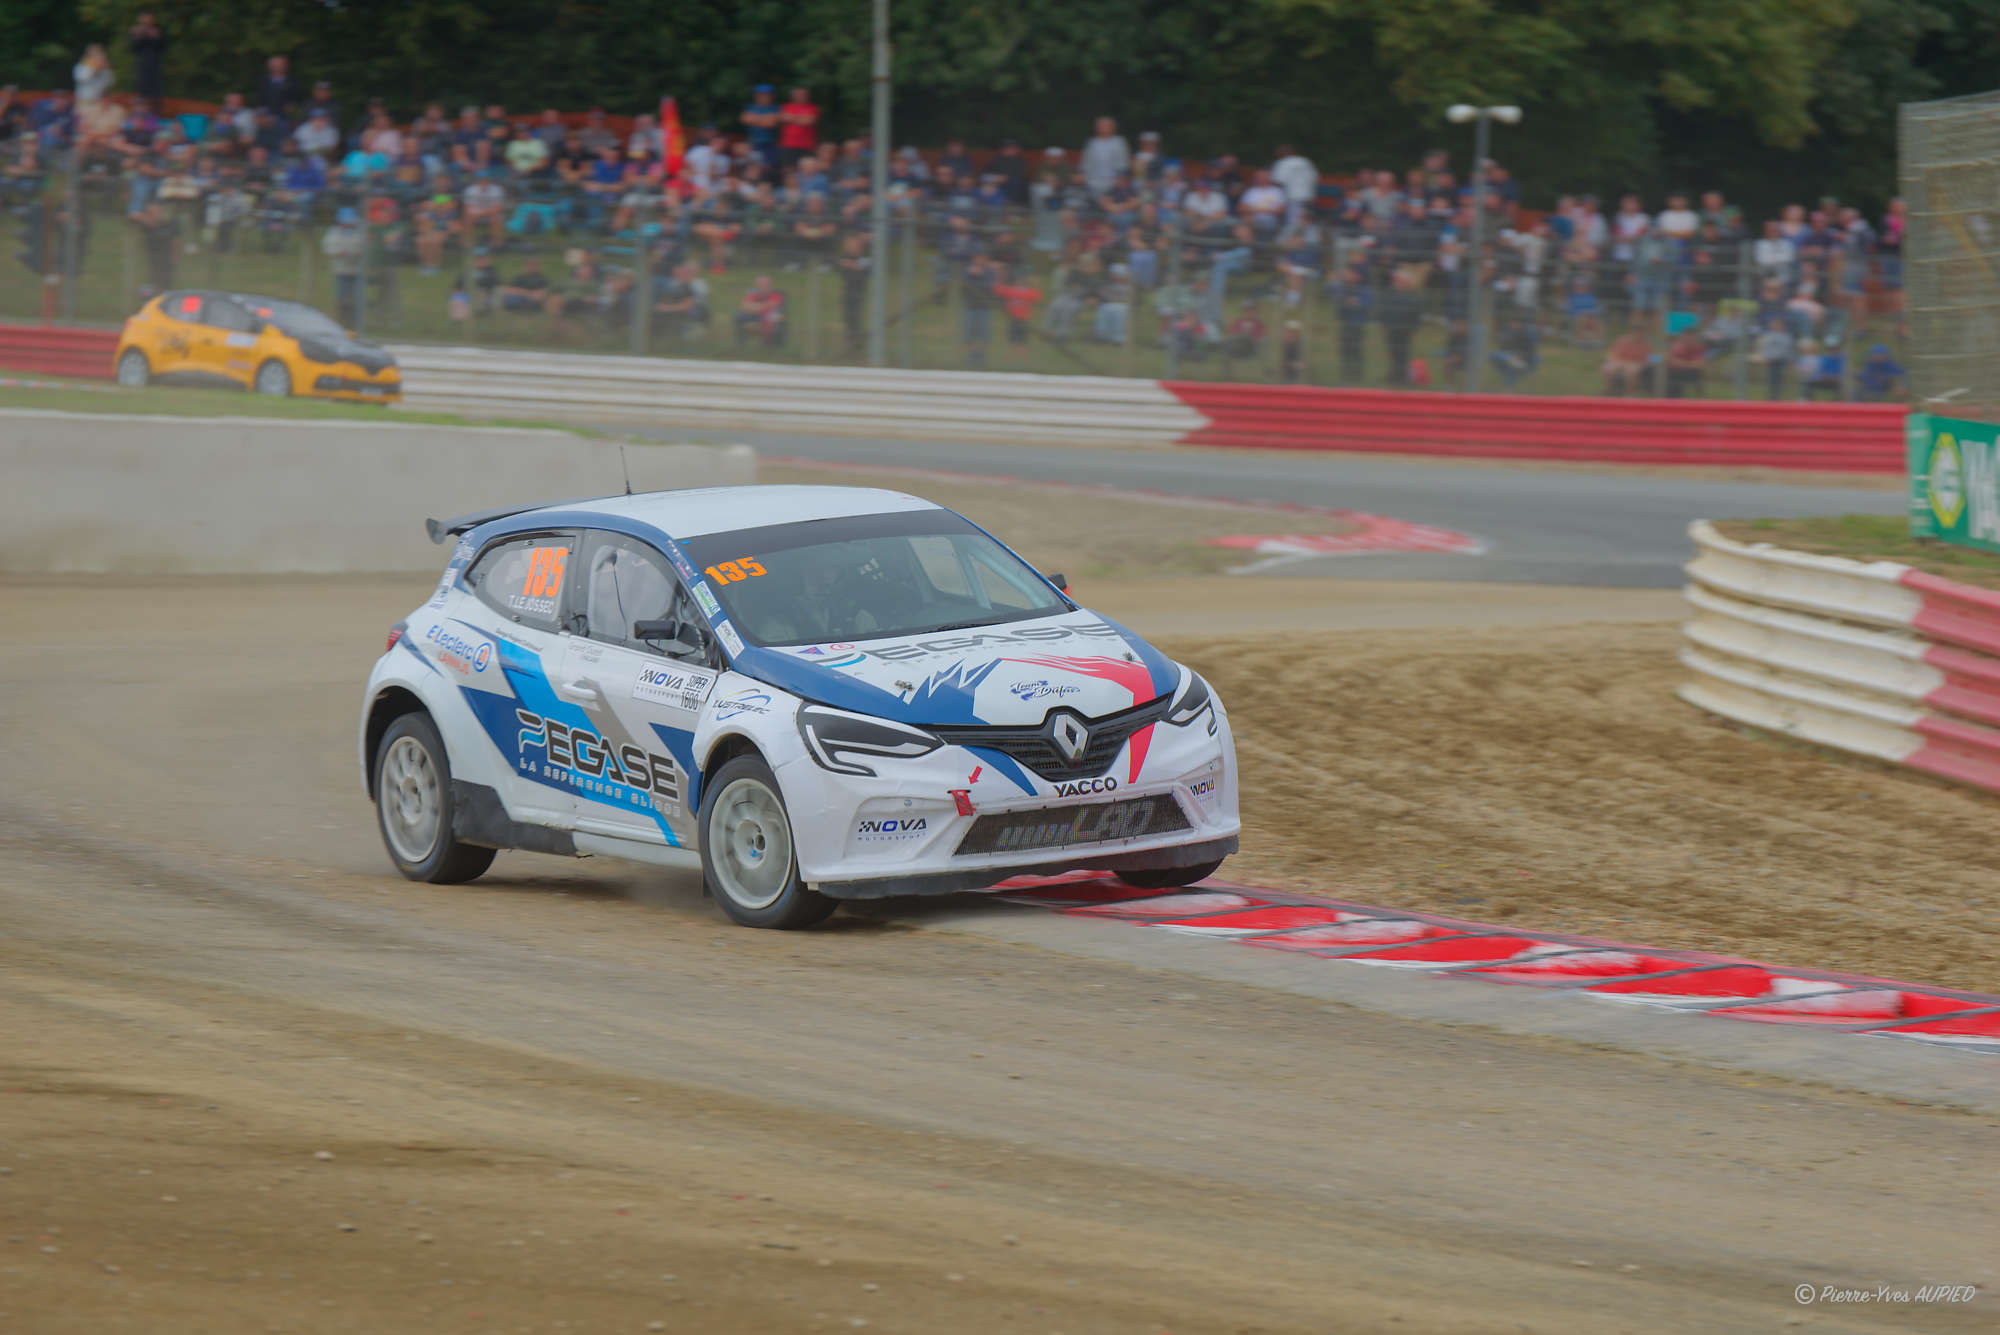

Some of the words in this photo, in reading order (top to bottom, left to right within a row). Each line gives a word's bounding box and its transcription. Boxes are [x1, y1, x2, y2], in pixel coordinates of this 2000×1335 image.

[522, 547, 568, 597] 135
[705, 557, 767, 586] 135
[687, 675, 708, 689] SUPER
[680, 691, 699, 711] 1600
[515, 709, 680, 803] PEGASE
[520, 758, 537, 773] LA
[1053, 777, 1117, 798] YACCO
